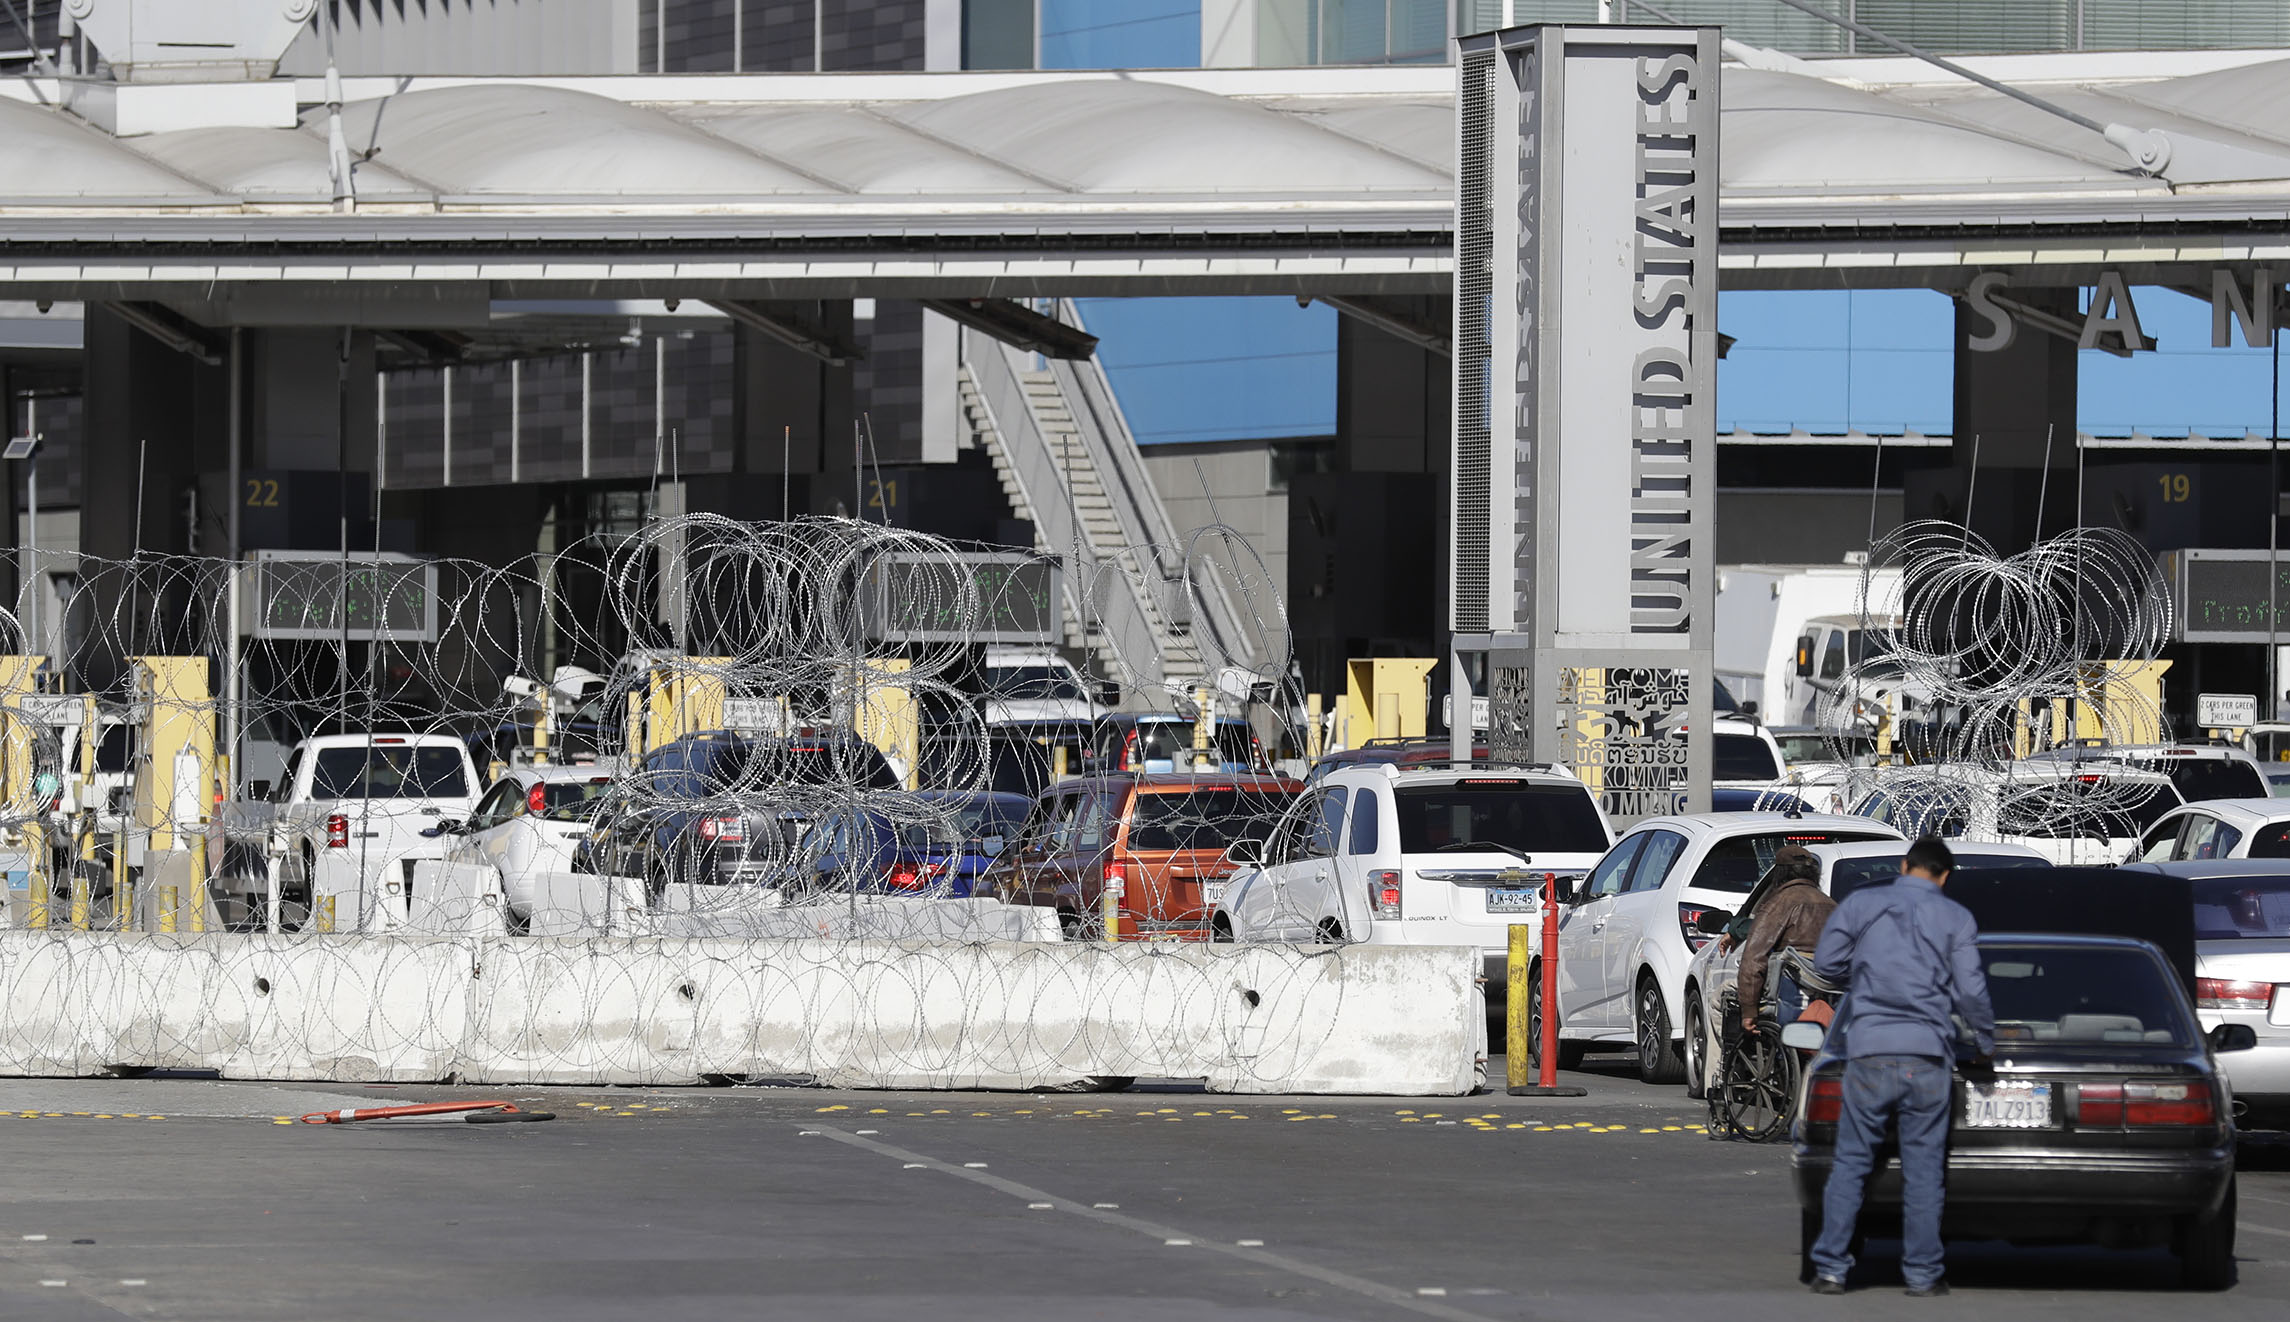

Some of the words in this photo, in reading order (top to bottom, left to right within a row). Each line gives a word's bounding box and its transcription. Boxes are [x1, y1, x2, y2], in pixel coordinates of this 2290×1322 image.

[1633, 53, 1697, 316] STATES
[1968, 270, 2273, 352] SAN
[247, 480, 278, 507] 22
[868, 480, 897, 507] 21
[1630, 346, 1692, 626] UNITED
[2159, 474, 2190, 502] 19
[1557, 667, 1688, 689] WELCOME
[2206, 701, 2220, 709] CARS
[2235, 702, 2253, 710] GREEN
[2227, 713, 2242, 721] LANE
[1562, 765, 1688, 787] ILLKOMMEN
[1490, 894, 1533, 905] AJK-92-45
[1975, 1101, 2046, 1120] 7ALZ913
